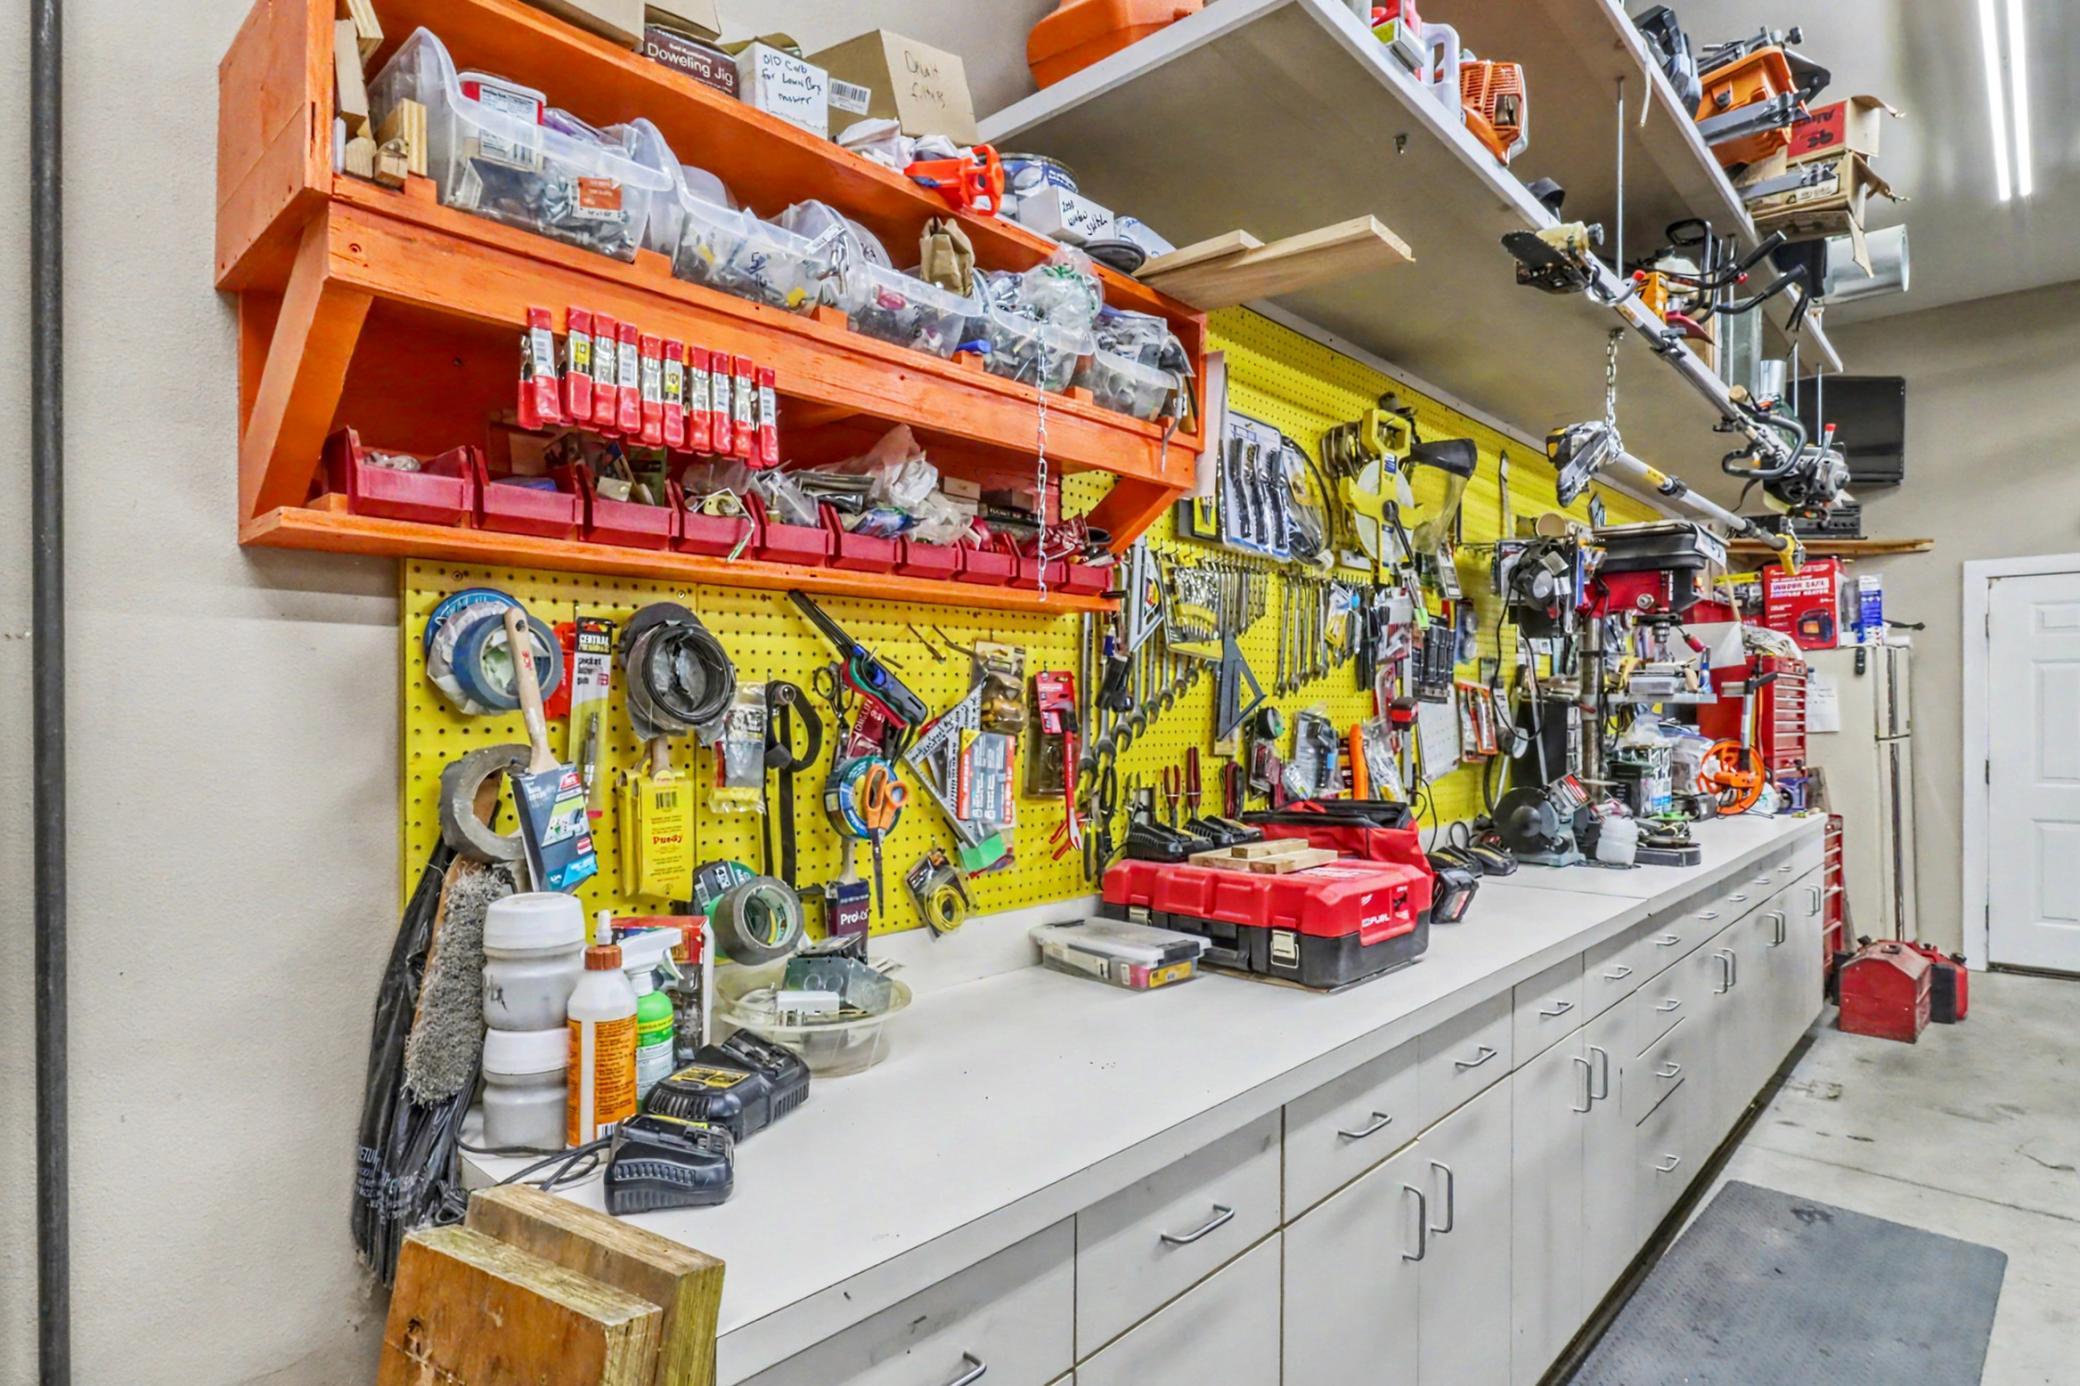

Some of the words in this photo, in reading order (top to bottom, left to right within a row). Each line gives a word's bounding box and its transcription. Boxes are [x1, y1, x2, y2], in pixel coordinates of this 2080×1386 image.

[647, 42, 711, 78] Doweling
[714, 66, 734, 86] Jig
[652, 834, 683, 845] Purdy
